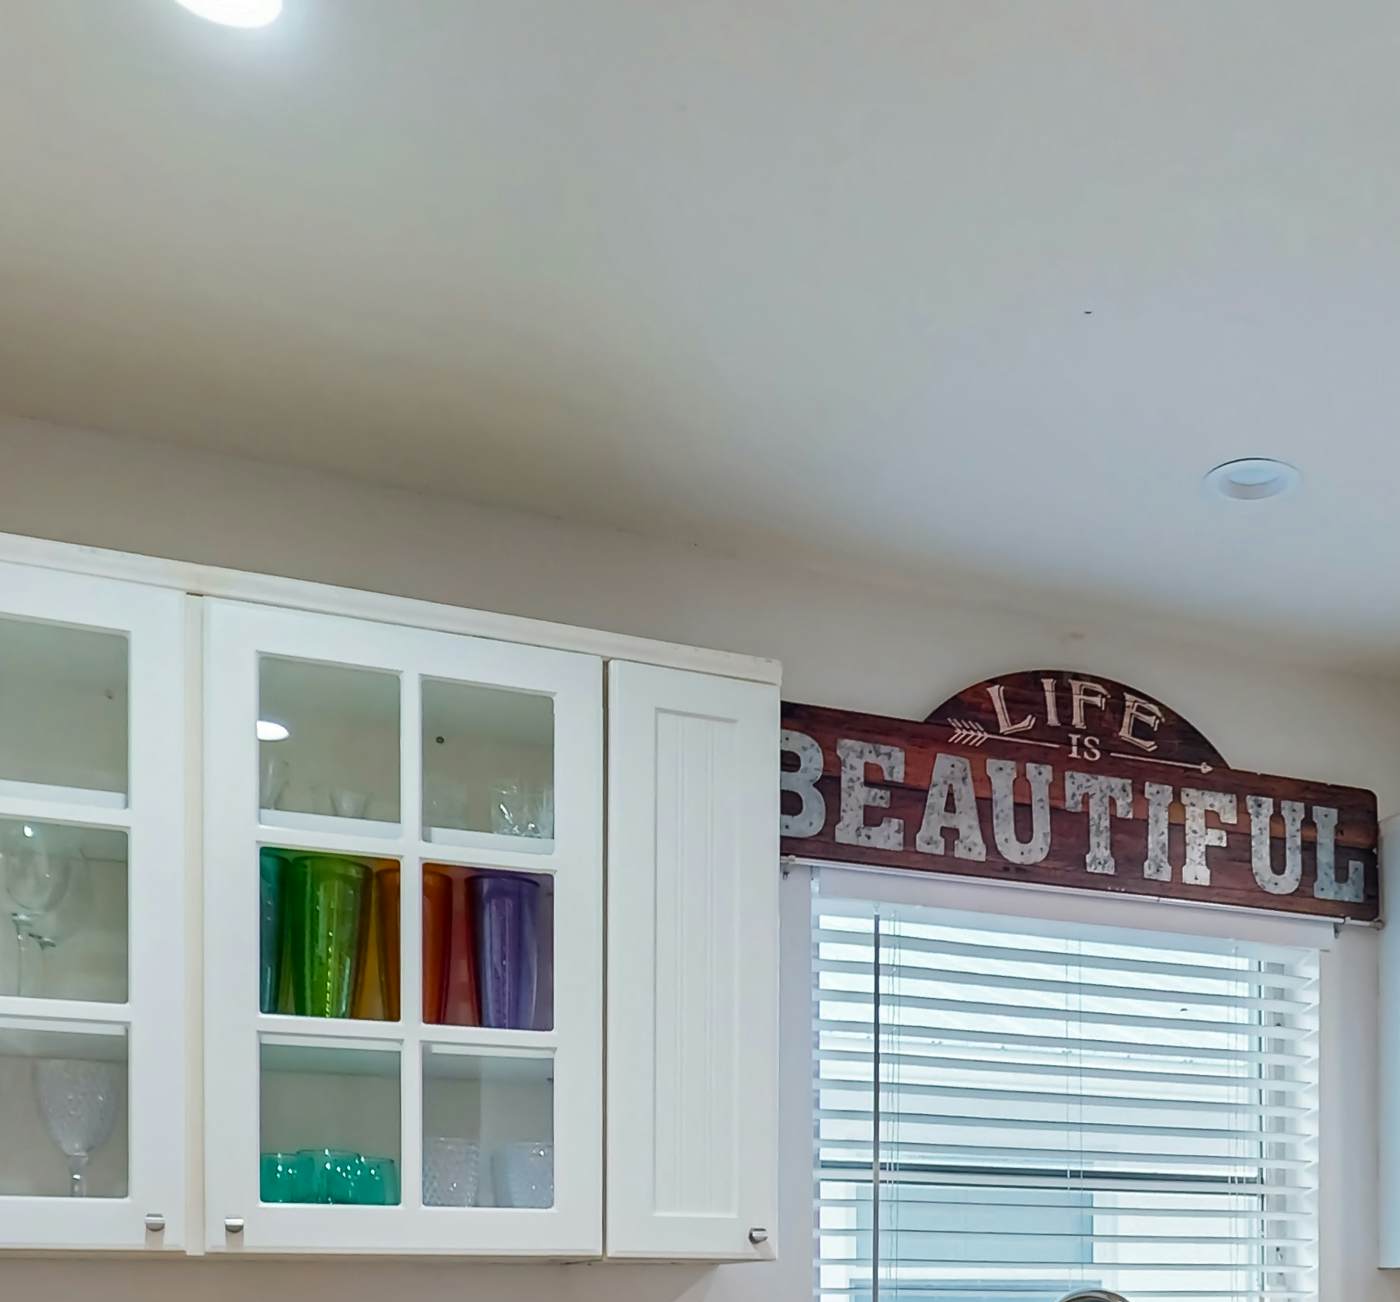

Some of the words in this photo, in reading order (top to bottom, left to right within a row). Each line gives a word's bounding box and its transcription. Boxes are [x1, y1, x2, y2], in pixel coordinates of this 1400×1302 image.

[987, 678, 1165, 751] LIFE
[1068, 734, 1101, 762] IS
[781, 730, 1365, 902] BEAUTIFUL
